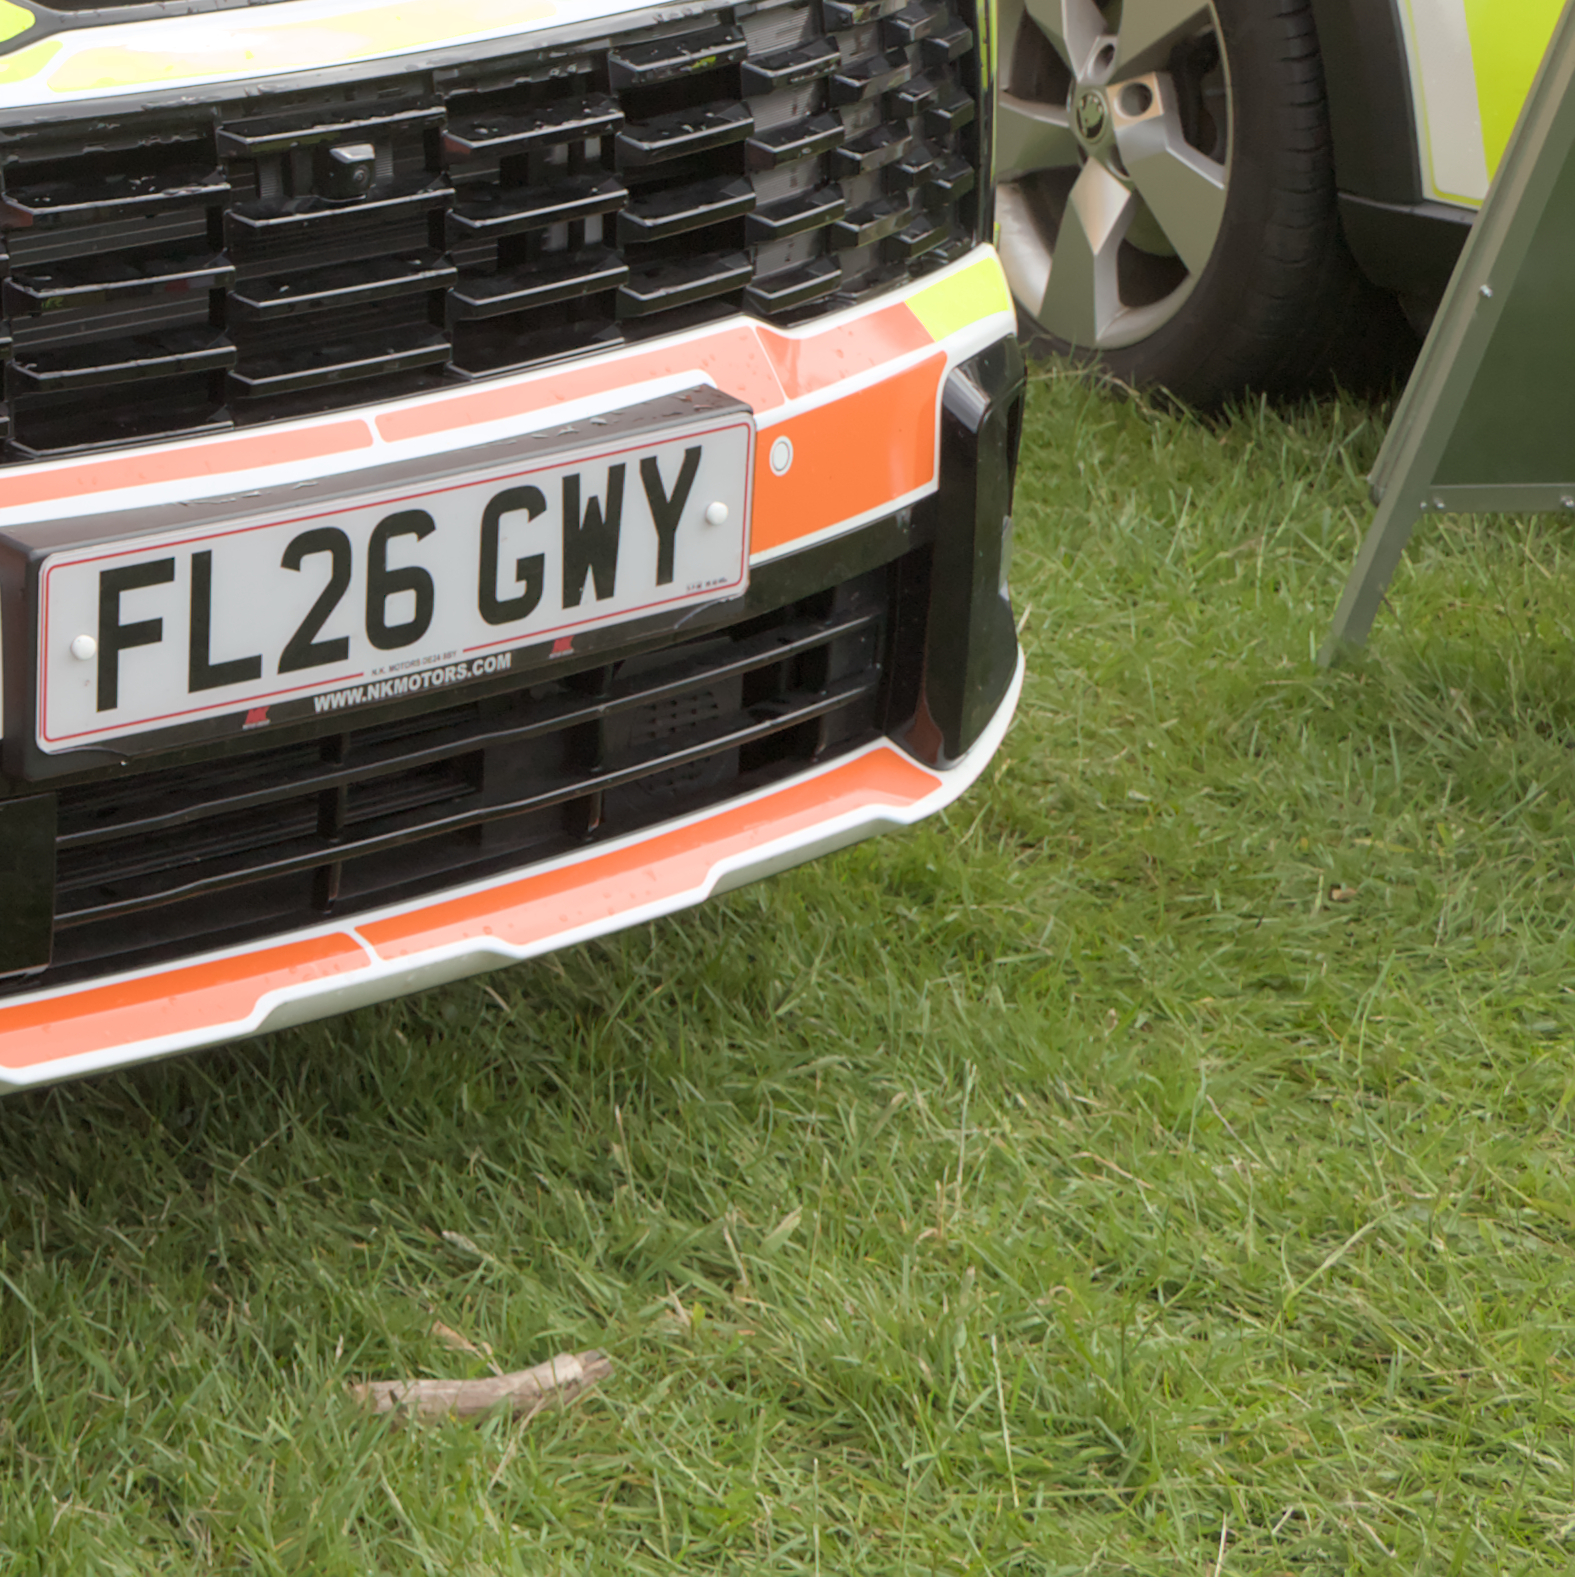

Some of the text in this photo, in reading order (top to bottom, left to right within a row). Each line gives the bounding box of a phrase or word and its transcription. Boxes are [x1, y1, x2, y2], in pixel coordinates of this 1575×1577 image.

[96, 445, 703, 713] FL26 GWY
[313, 652, 512, 713] WWW.NKMOTORS.COM
[389, 658, 421, 673] MOTORS
